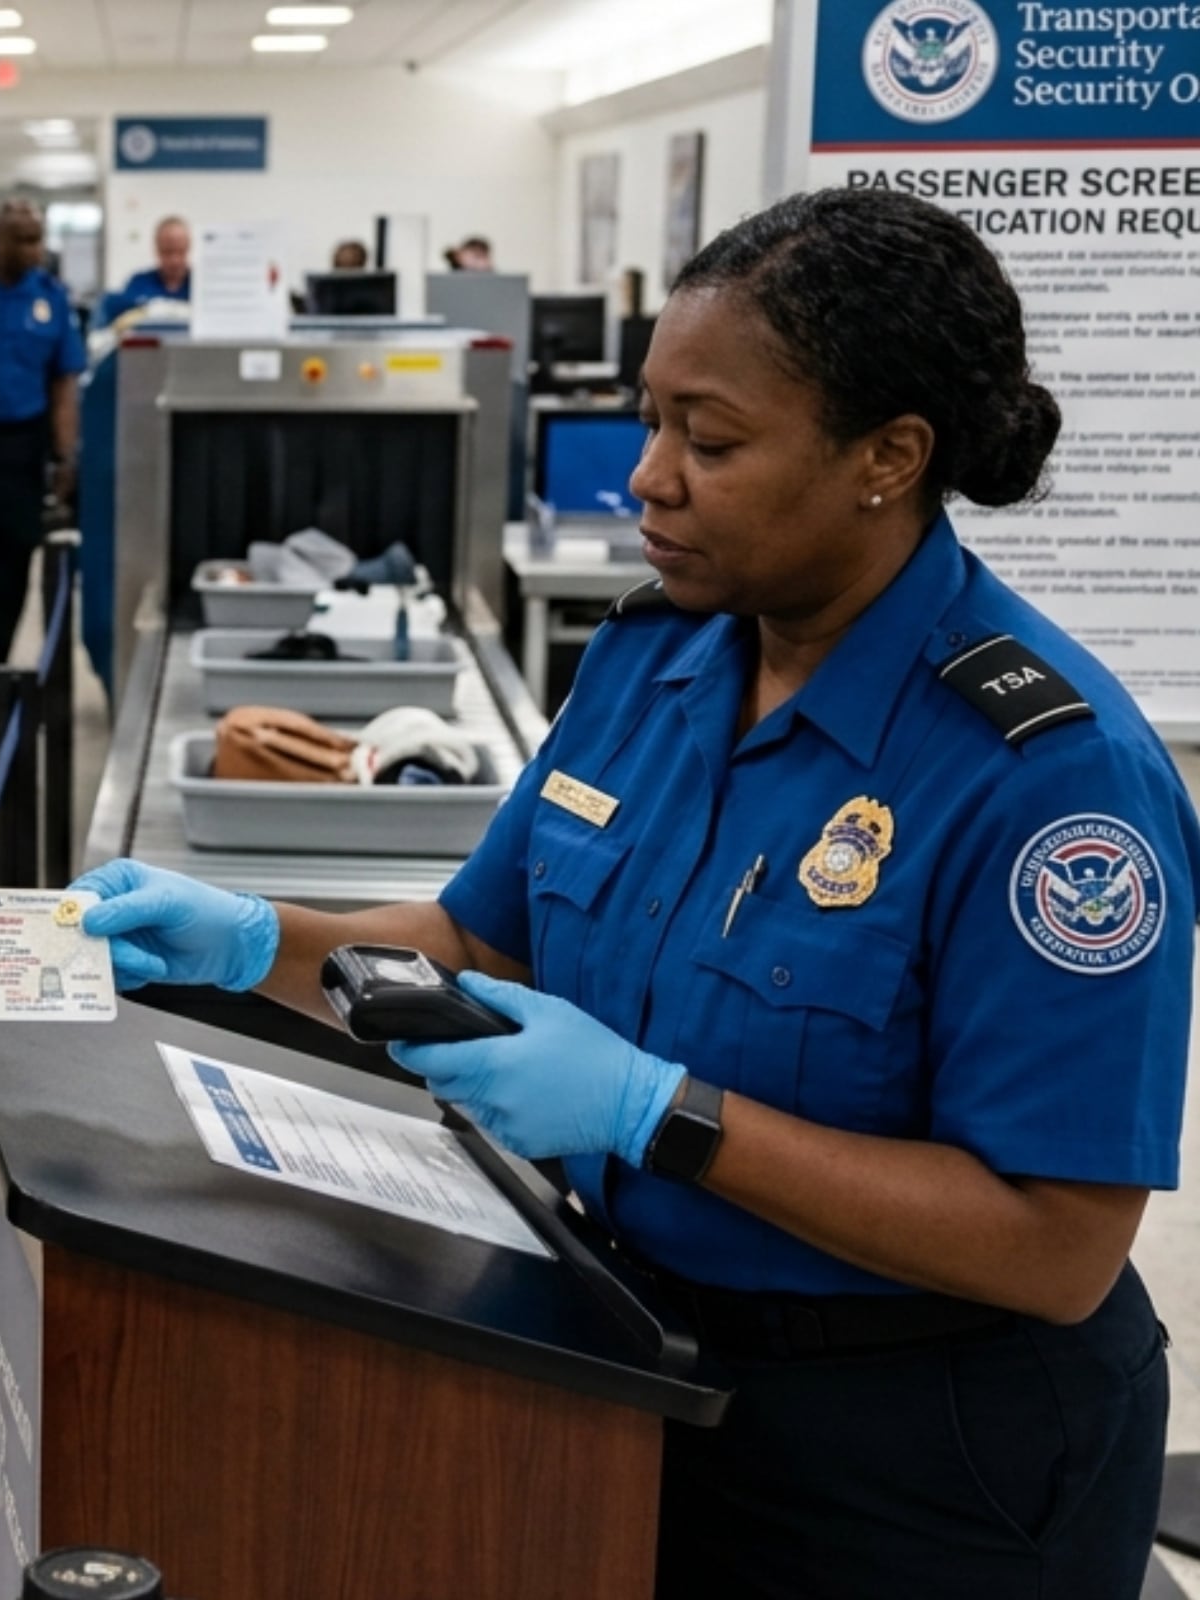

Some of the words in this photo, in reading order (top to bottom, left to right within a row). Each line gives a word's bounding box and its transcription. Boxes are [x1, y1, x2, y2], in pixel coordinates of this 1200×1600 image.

[1015, 38, 1165, 74] Security
[1013, 75, 1163, 111] Security
[1169, 72, 1200, 104] O
[847, 168, 1068, 198] PASSENGER
[1080, 167, 1200, 197] SCREE
[981, 666, 1046, 695] TSA
